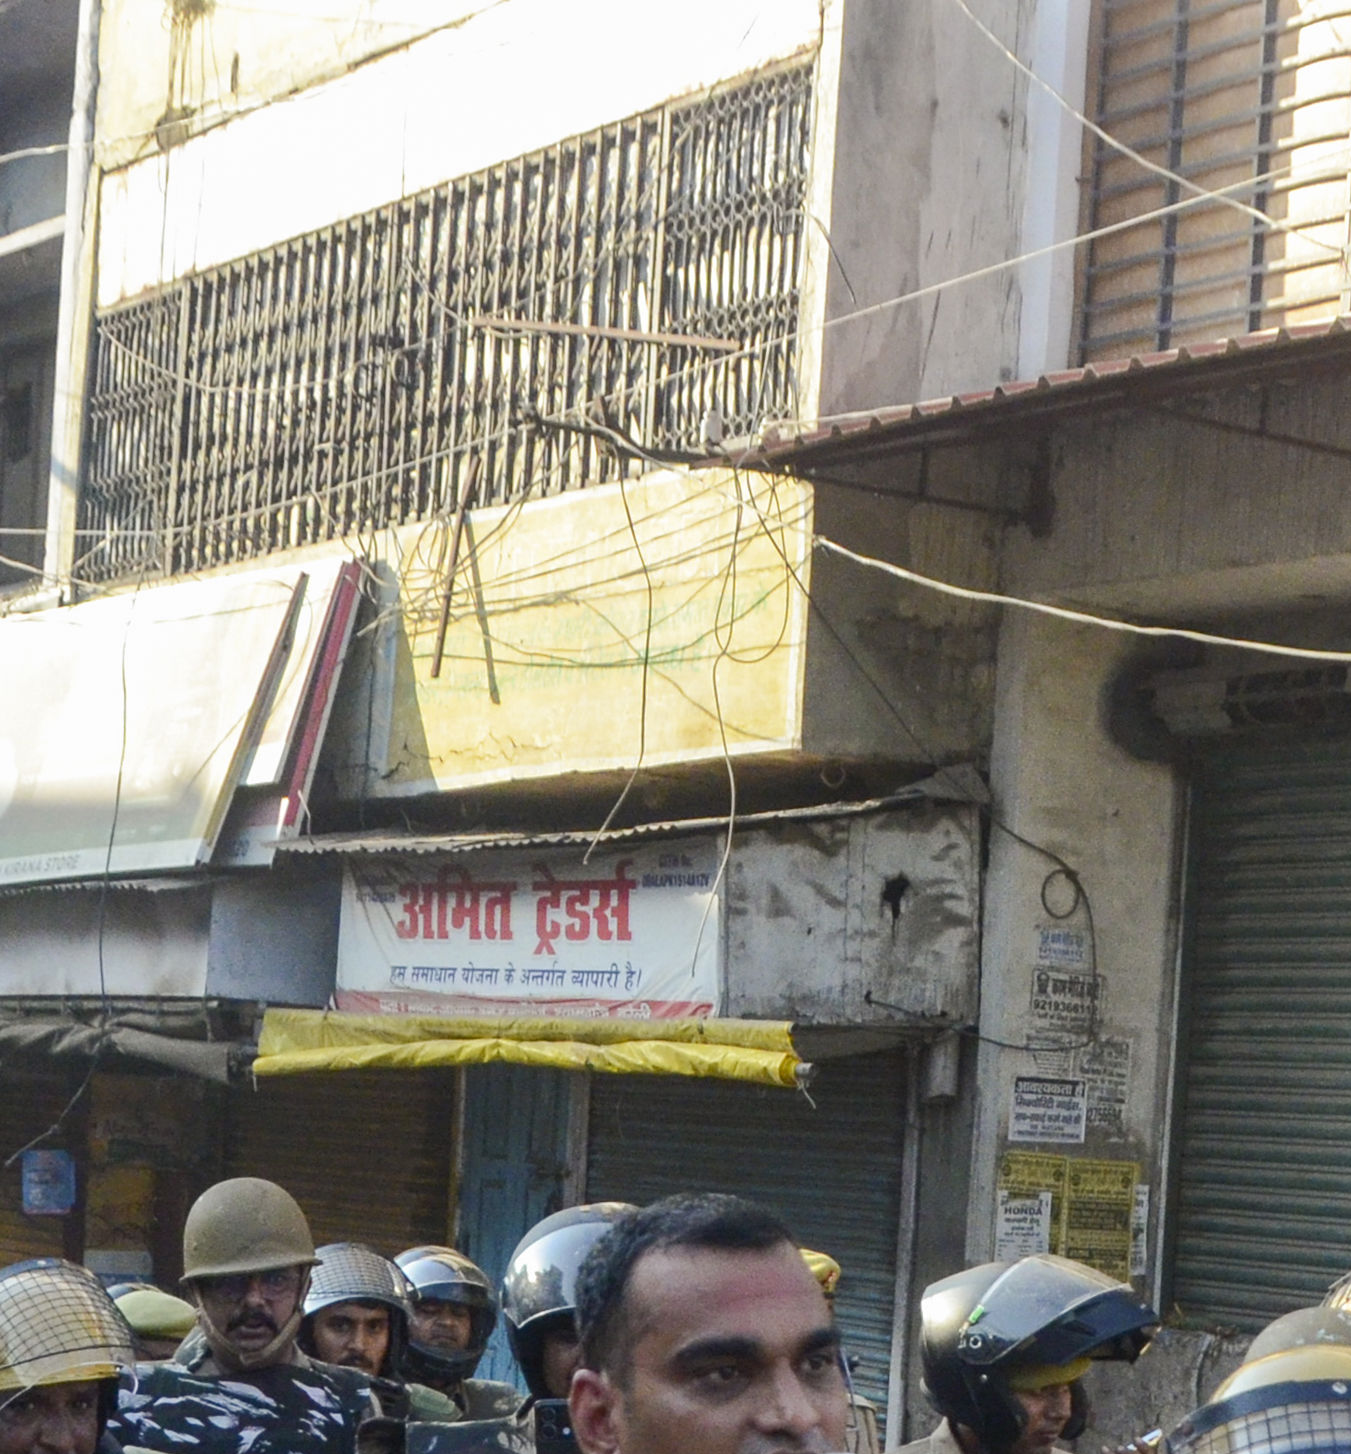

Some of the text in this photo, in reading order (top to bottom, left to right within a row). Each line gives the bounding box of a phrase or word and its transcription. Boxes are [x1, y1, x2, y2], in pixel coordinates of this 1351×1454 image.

[43, 853, 81, 872] STORE
[396, 857, 637, 956] अमित ट्रेडर्स
[390, 965, 406, 984] हम
[411, 965, 456, 985] समाधान
[461, 961, 500, 985] योजना
[504, 962, 516, 985] के
[521, 960, 567, 986] अन्तर्गत
[571, 962, 621, 988] व्यापारी
[1004, 1206, 1043, 1216] HONDA
